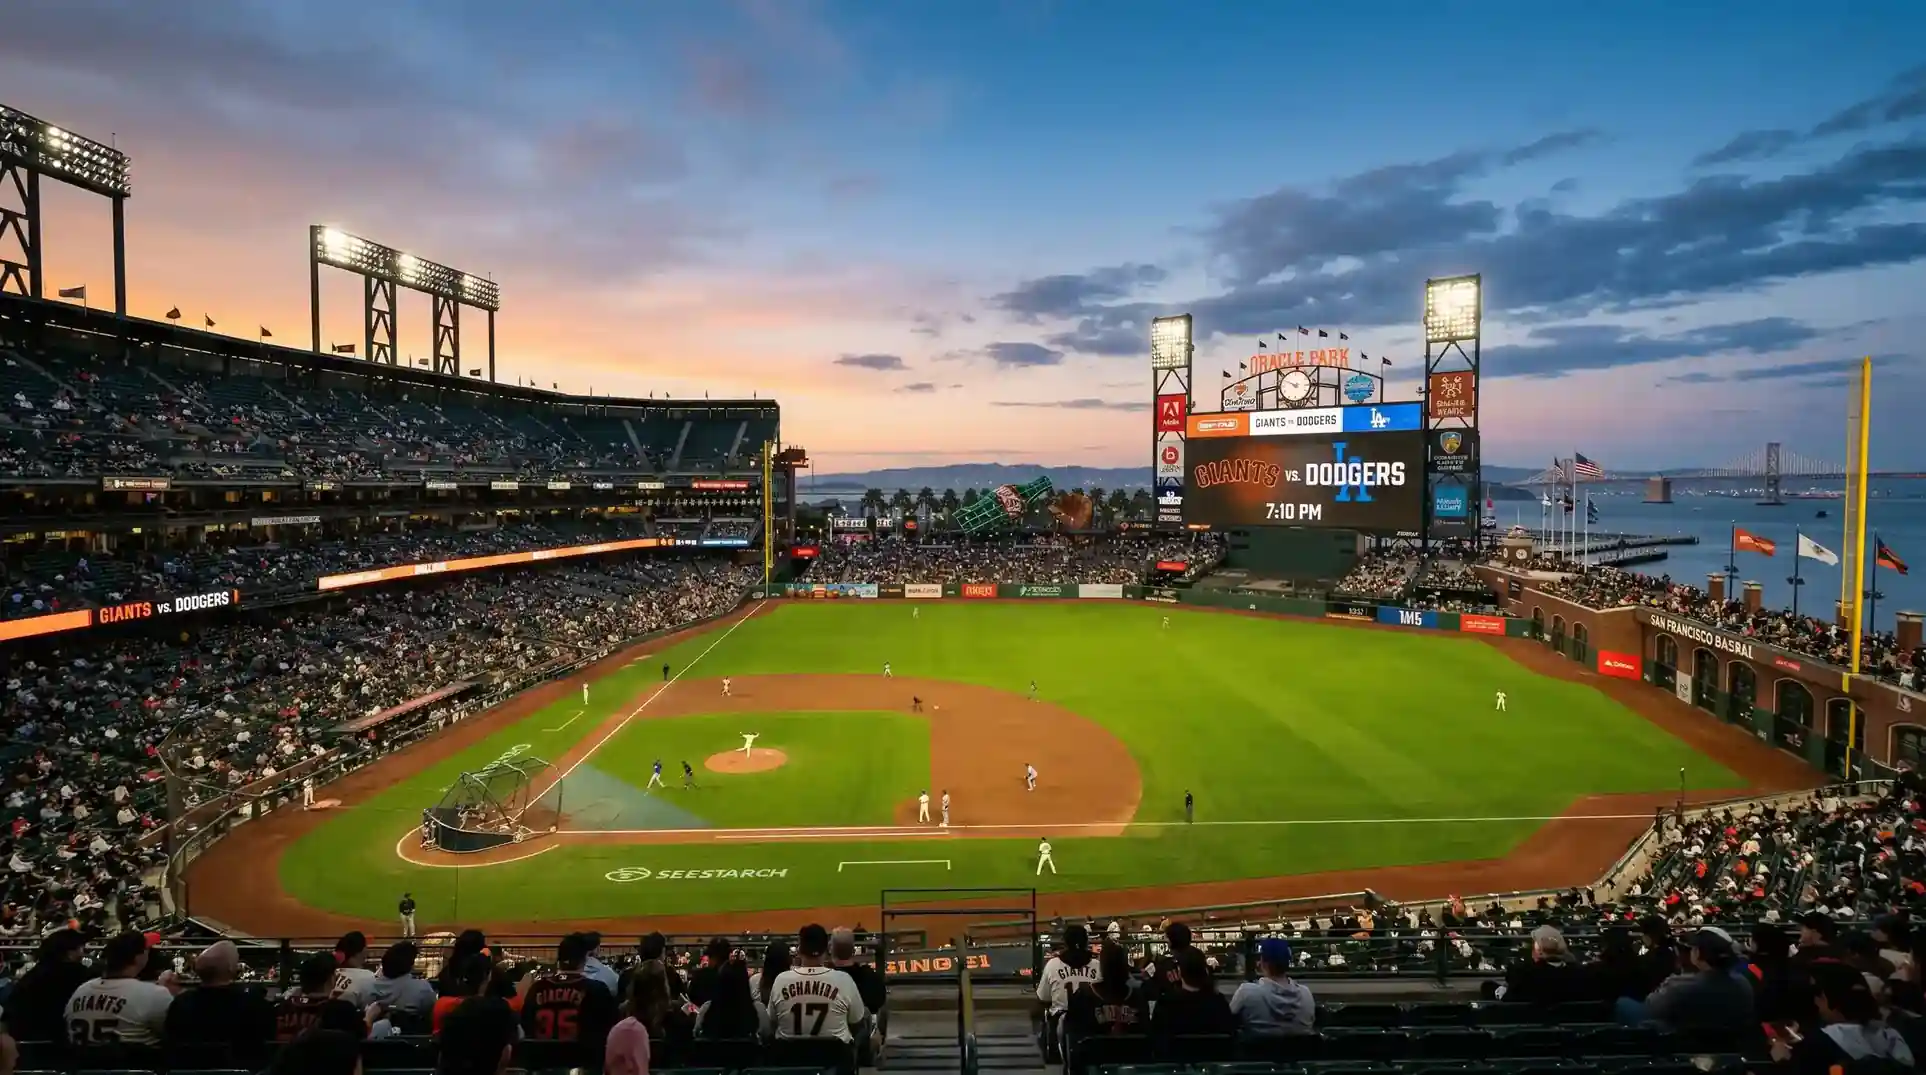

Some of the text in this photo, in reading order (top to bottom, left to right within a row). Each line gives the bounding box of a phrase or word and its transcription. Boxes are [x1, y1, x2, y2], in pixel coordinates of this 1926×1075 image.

[1250, 347, 1350, 375] ORACLE PARK
[1255, 417, 1286, 428] GIANTS
[1296, 415, 1337, 426] DODGERS
[1194, 459, 1281, 488] GIANTS
[1305, 462, 1405, 486] DODGERS
[1266, 503, 1322, 521] 7:10 PM
[100, 602, 152, 624] GIANTS
[175, 591, 229, 613] DODGERS
[1651, 614, 1666, 629] SAN
[1666, 618, 1713, 645] FRANCISCO
[656, 868, 789, 879] SEESTARCH
[1058, 966, 1097, 979] GIANTS
[73, 994, 127, 1014] GIANTS
[789, 1003, 829, 1036] 17
